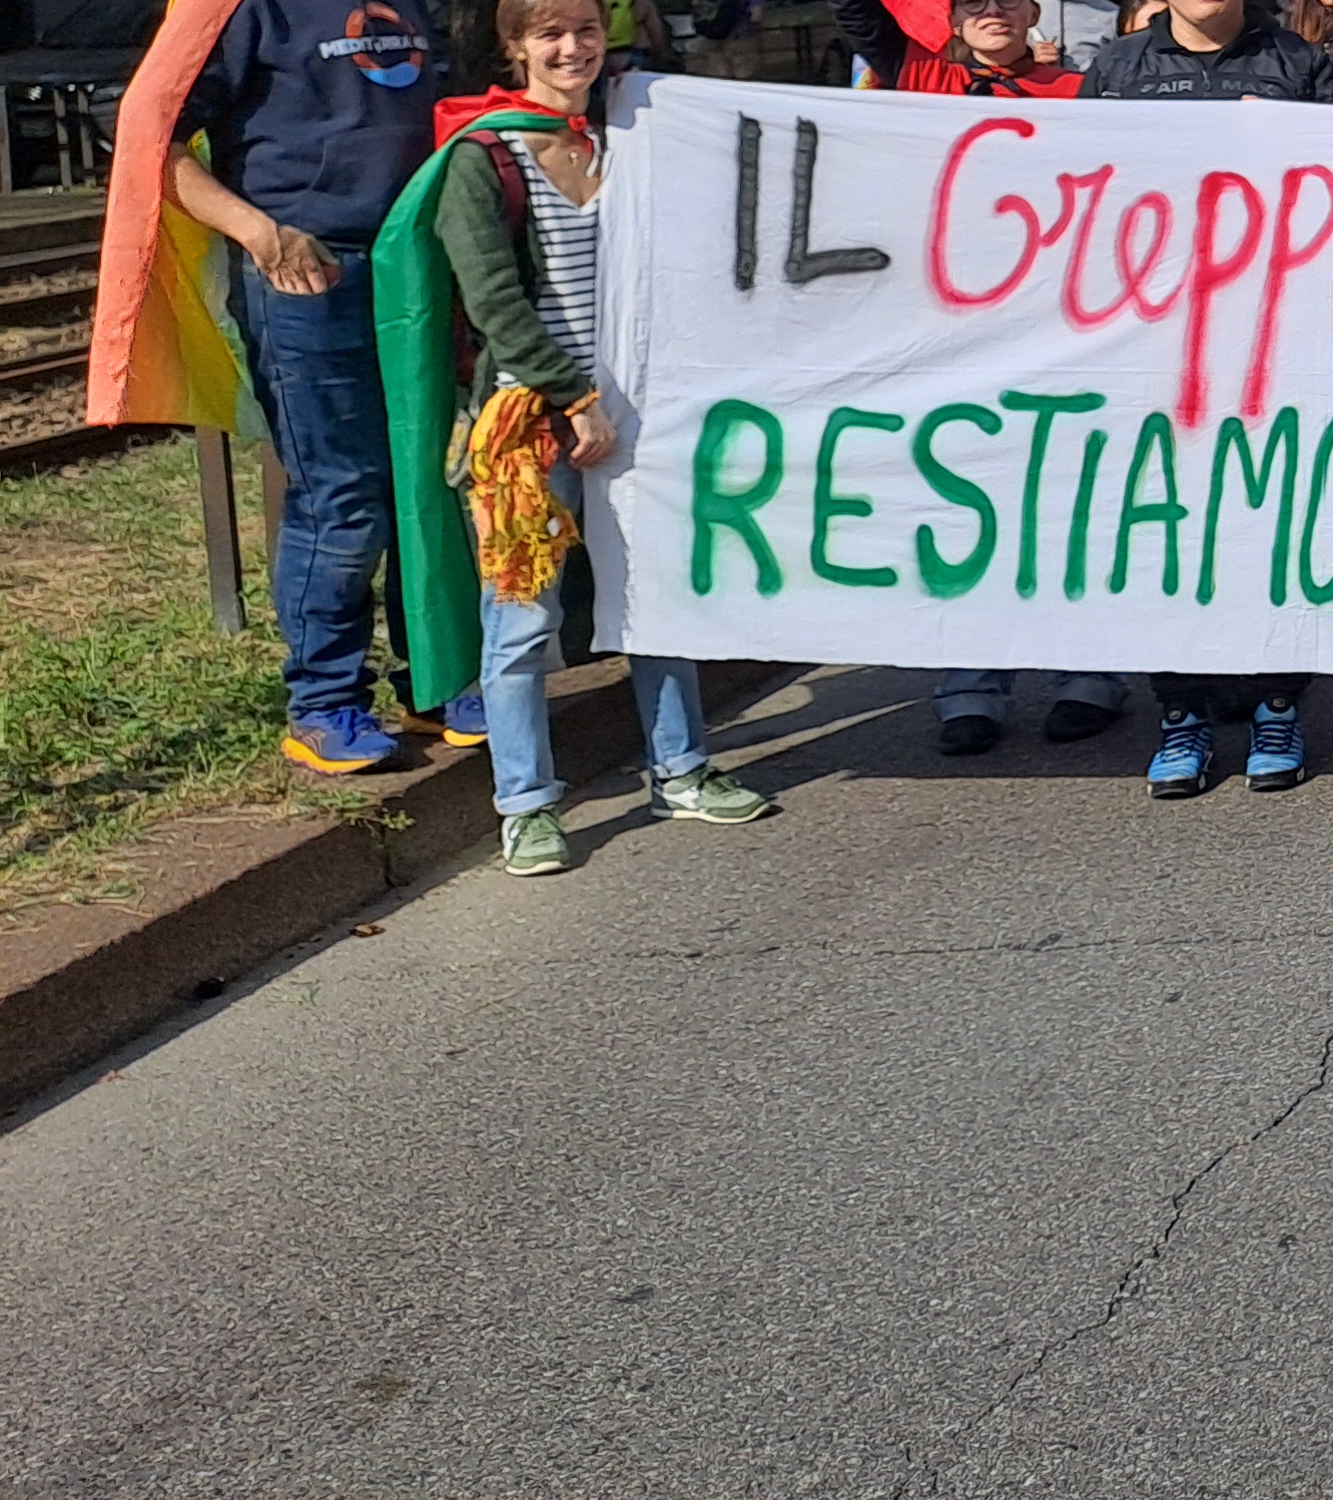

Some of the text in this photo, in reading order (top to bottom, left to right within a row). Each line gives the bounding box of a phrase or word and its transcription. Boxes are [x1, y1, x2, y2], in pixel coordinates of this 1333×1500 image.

[1156, 79, 1276, 96] AIR MAX
[733, 112, 892, 292] IL
